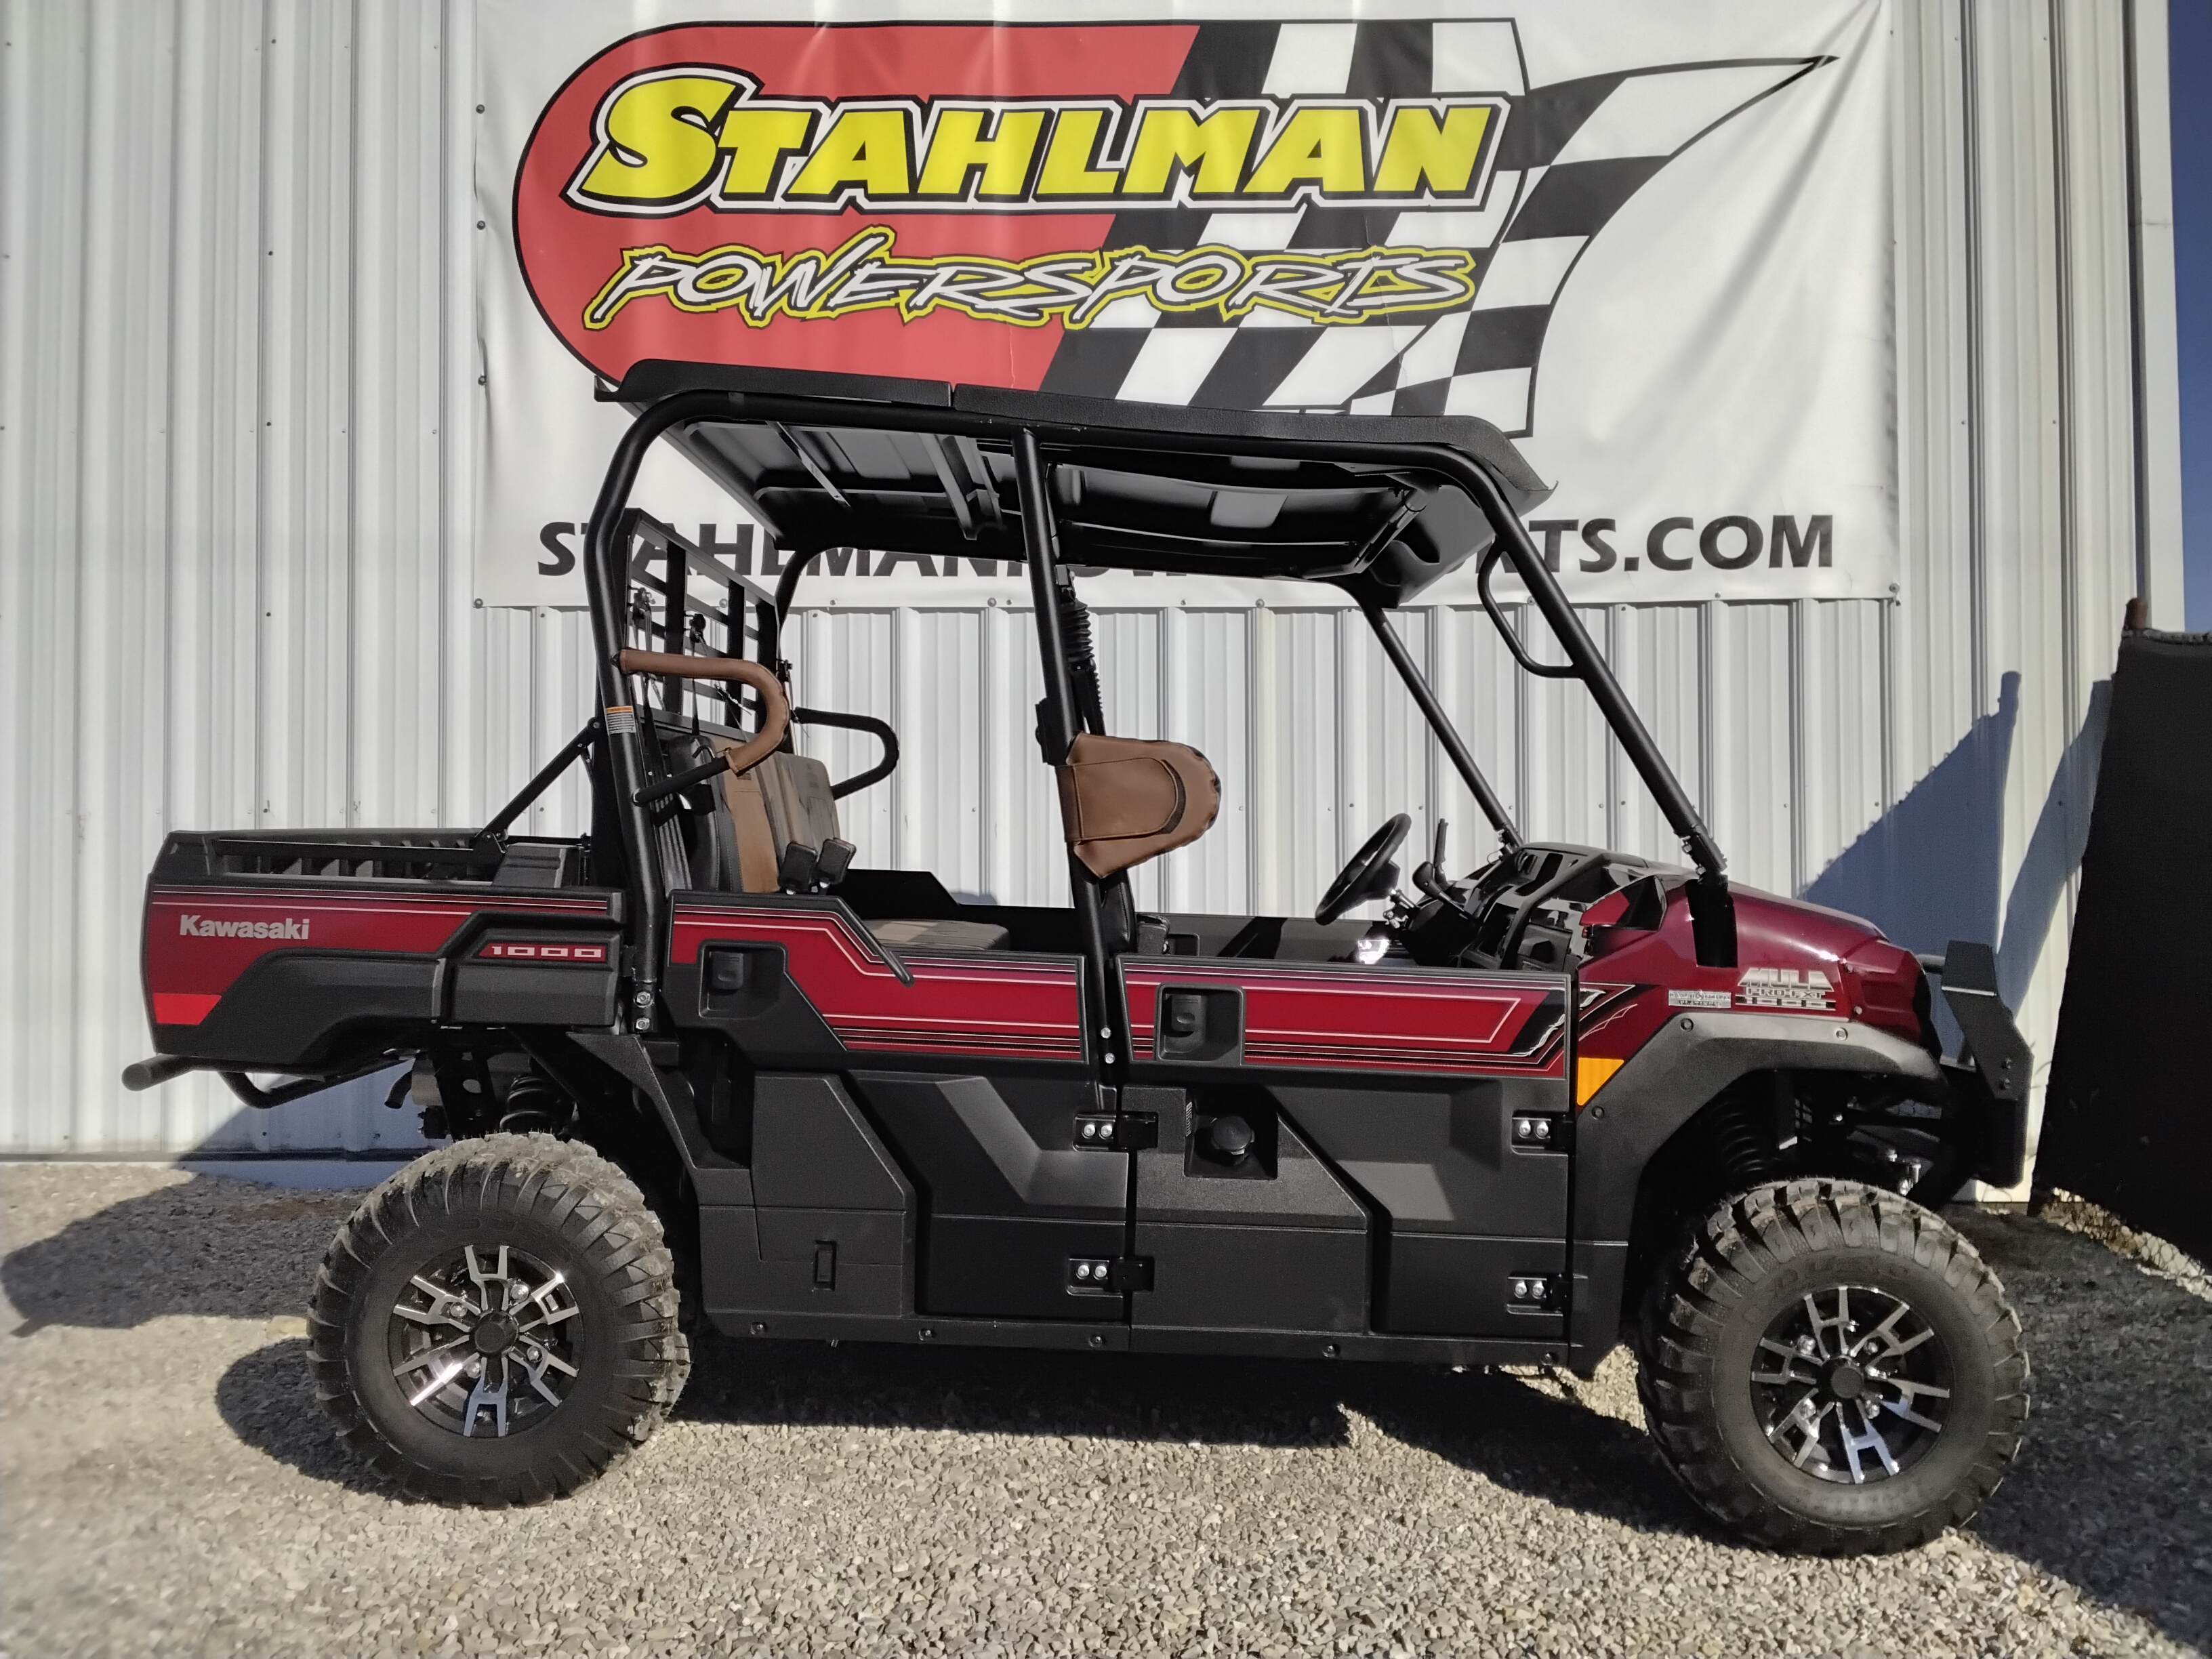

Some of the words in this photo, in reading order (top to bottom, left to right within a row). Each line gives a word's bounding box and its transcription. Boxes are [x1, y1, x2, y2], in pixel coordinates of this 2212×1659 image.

[569, 69, 1501, 209] STAHLMAN
[588, 229, 1471, 325] POWERSPORTS
[180, 914, 310, 940] Kawasaki
[491, 946, 602, 958] 1000
